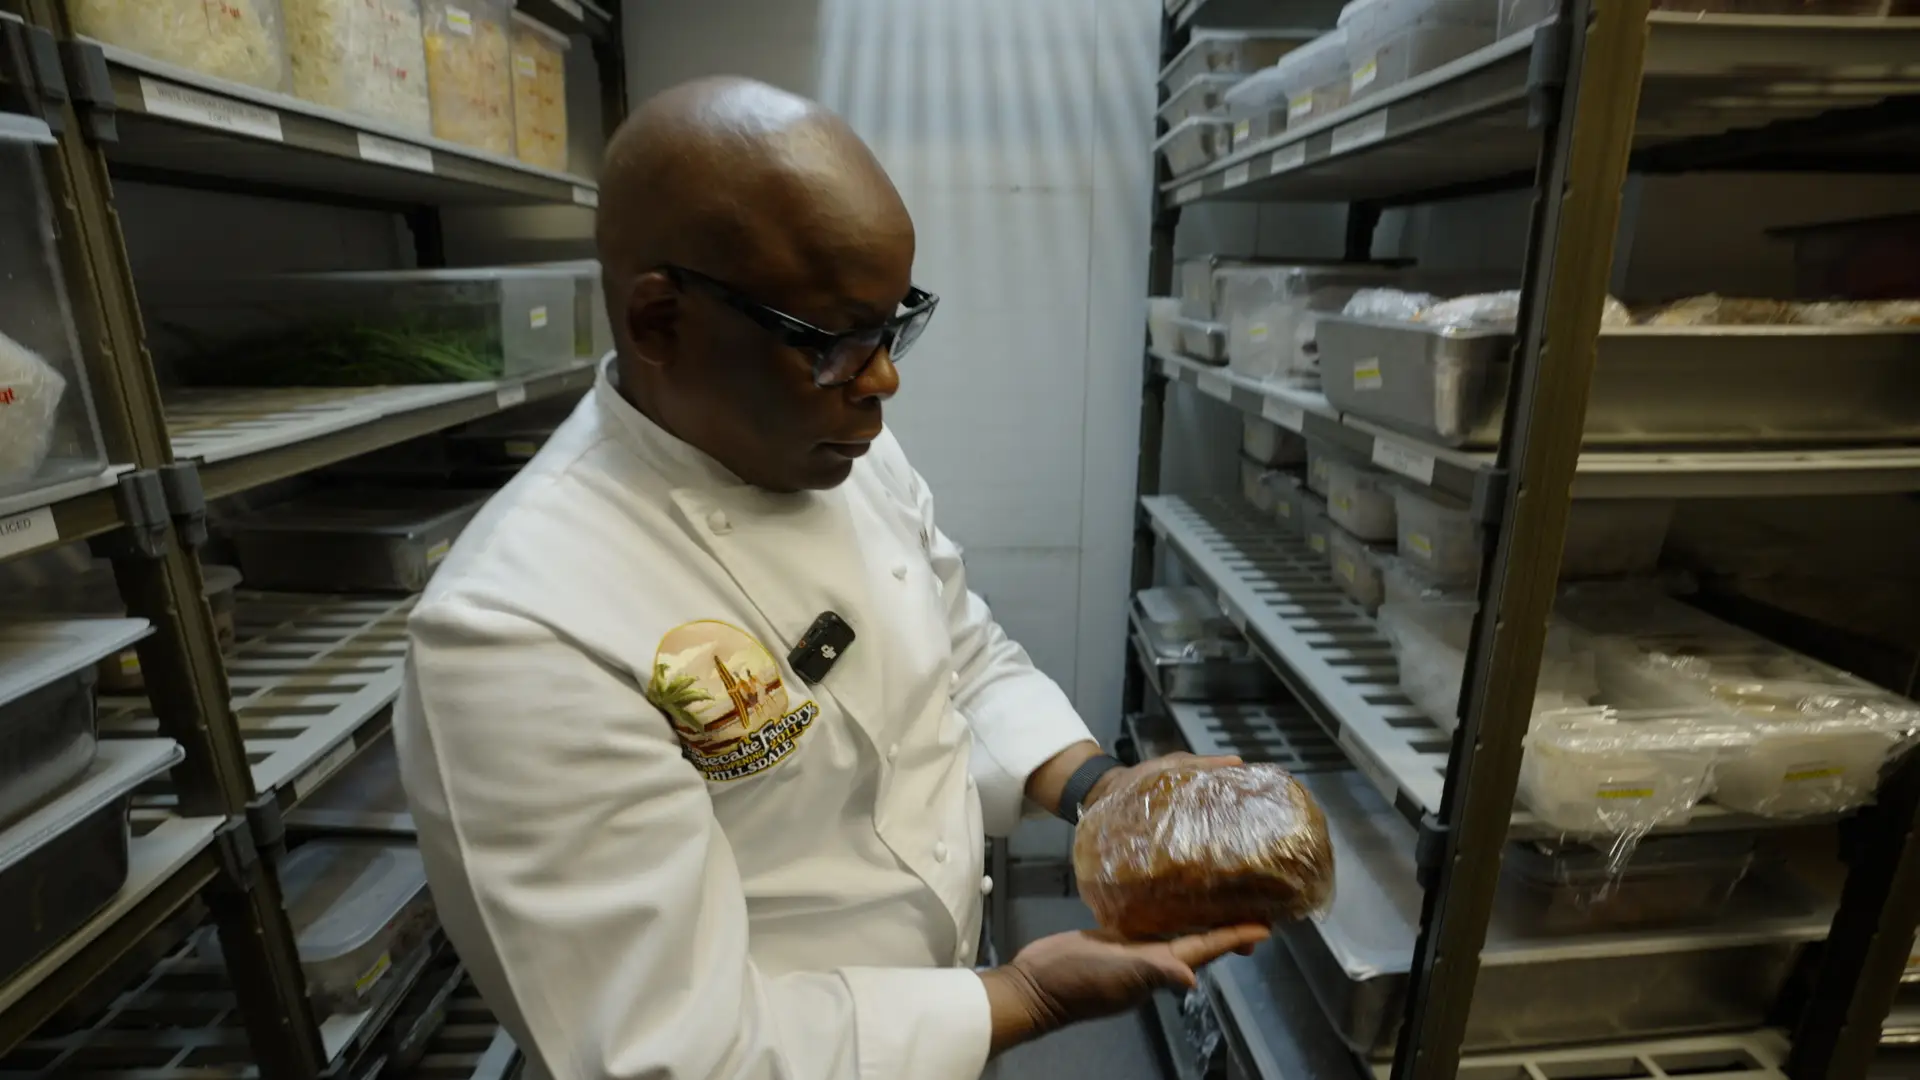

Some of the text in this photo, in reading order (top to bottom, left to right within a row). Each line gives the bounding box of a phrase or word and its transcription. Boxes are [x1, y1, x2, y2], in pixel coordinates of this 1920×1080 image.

[692, 742, 761, 765] secake
[751, 703, 813, 755] Factory
[770, 724, 802, 749] 2011
[709, 739, 794, 781] HILLSDALE
